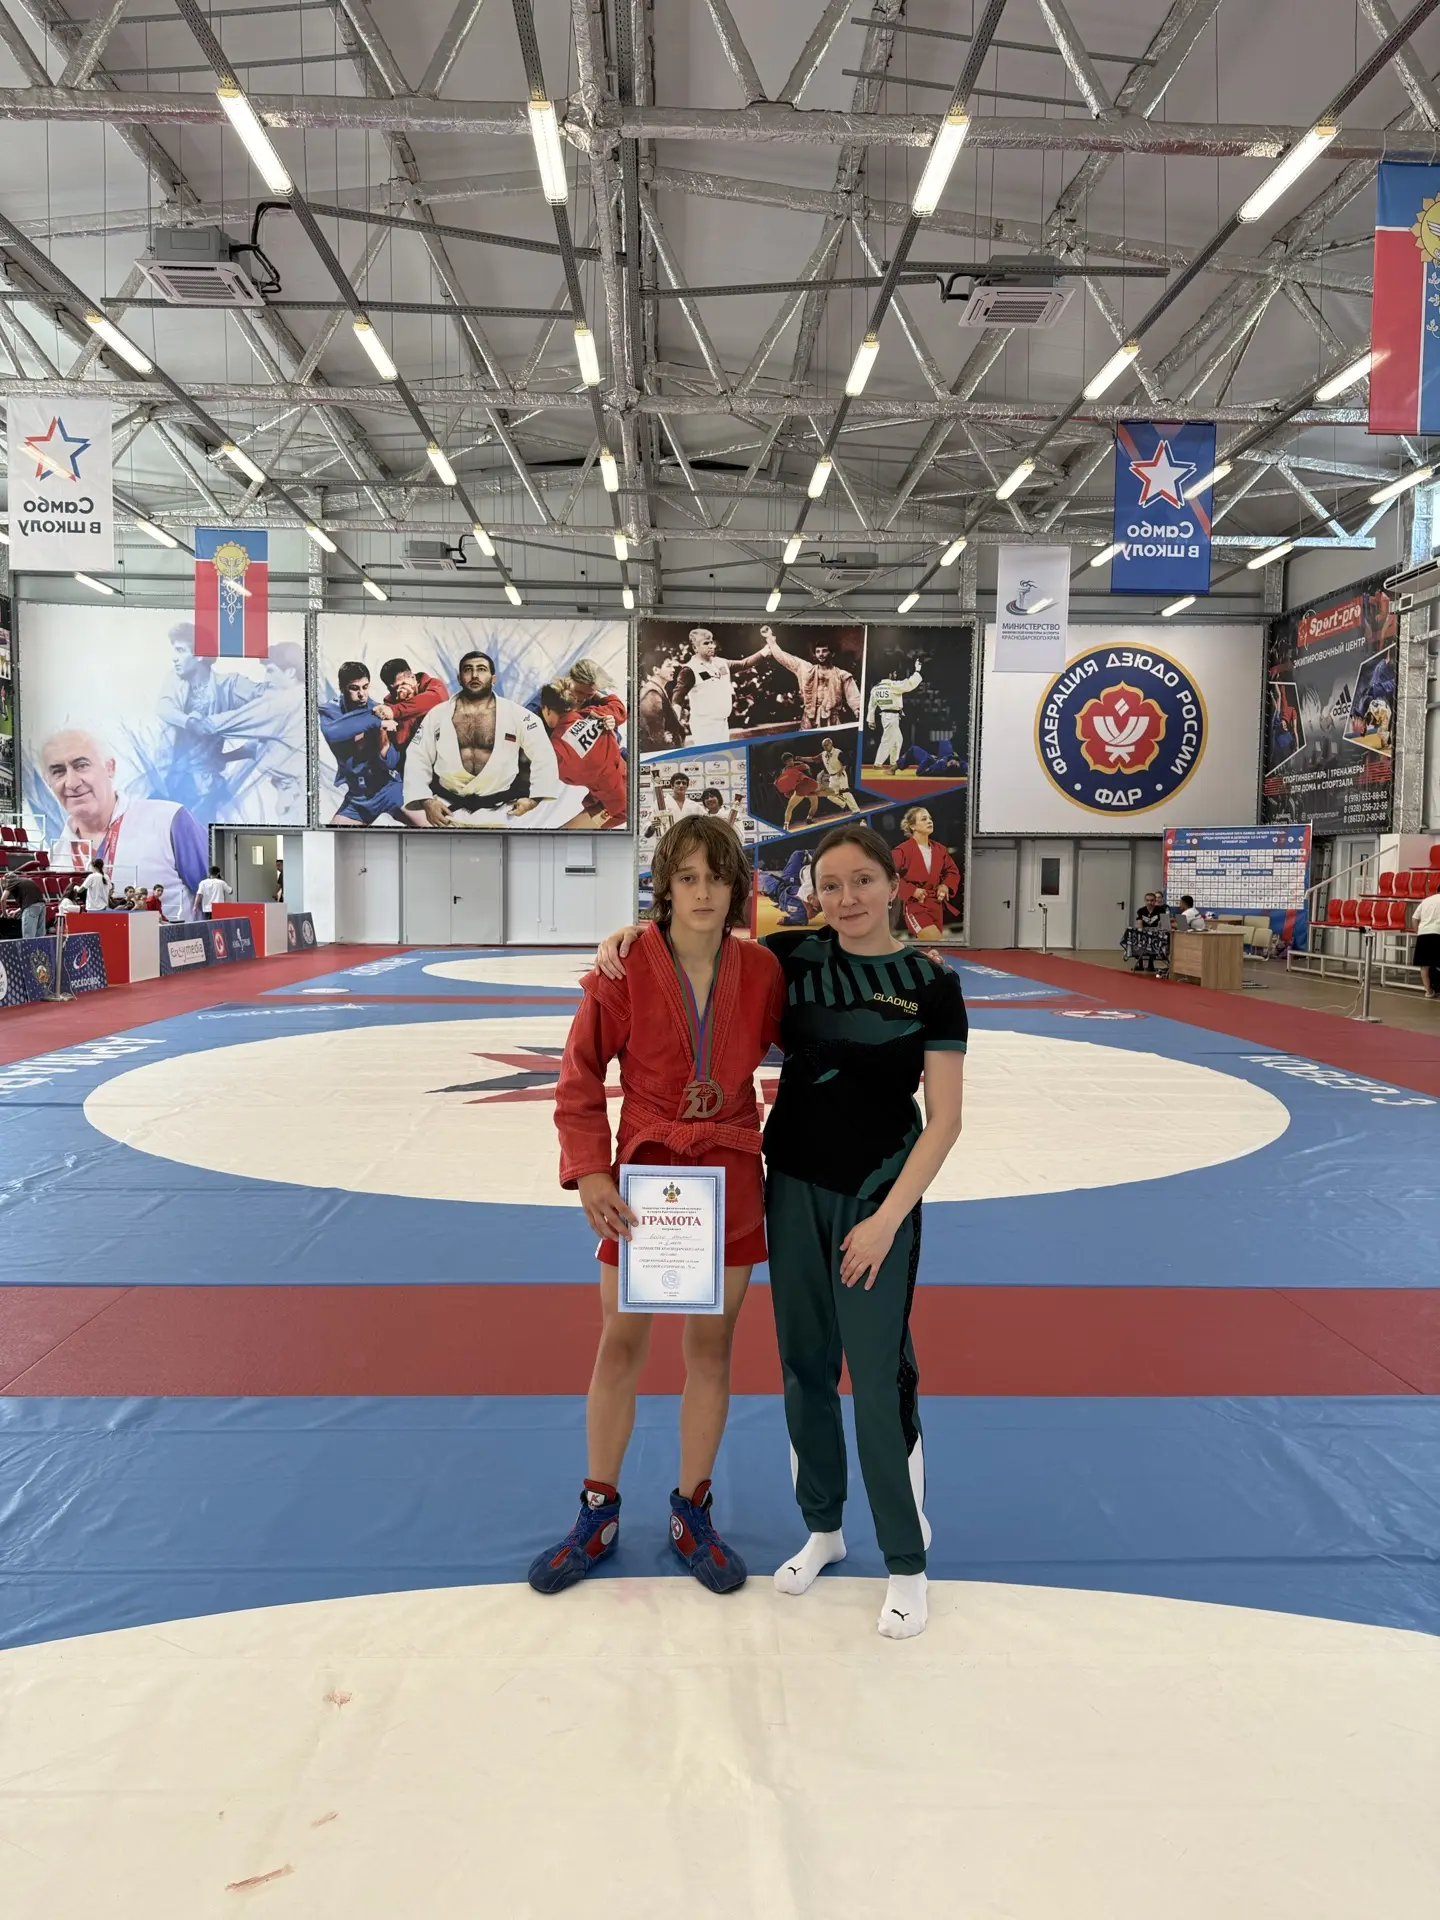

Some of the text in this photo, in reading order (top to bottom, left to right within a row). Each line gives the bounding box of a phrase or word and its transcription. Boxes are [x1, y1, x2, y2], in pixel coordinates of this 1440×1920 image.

[1002, 622, 1060, 630] МИНИСТЕРСТВО
[1309, 604, 1361, 637] Sport-pro
[1292, 636, 1366, 669] ЭКИПИРОВОЧНЫЙ ЦЕНТР
[1044, 652, 1198, 776] ФЕДЕРАЦИЯ ДЗЮДО РОССИИ
[1282, 770, 1326, 784] СПОРТИНВЕНТАРЬ
[1330, 764, 1365, 778] ТРЕНАЖЕРЫ
[1302, 783, 1316, 794] ДОМА
[1322, 778, 1354, 790] СПОРТЗАЛА
[1094, 788, 1142, 806] ФДР
[873, 992, 919, 1011] GLADIUS
[1240, 1055, 1437, 1106] КОВЕР 3
[641, 1216, 702, 1226] ГРАМОТА
